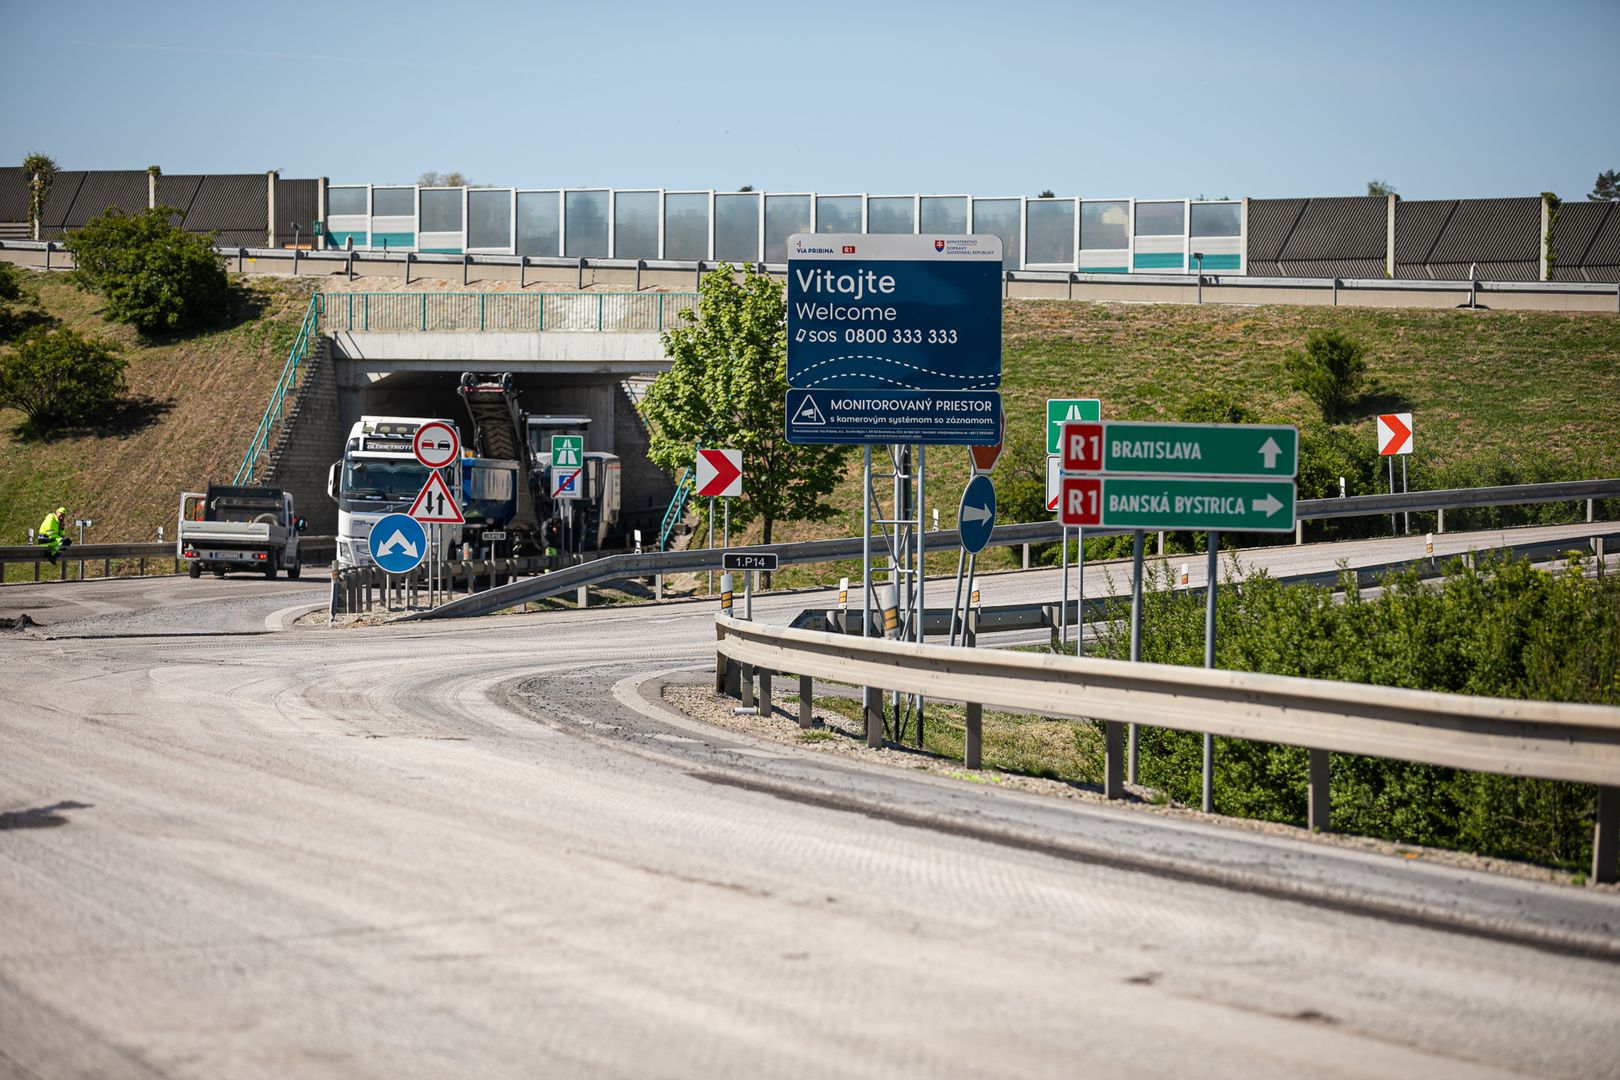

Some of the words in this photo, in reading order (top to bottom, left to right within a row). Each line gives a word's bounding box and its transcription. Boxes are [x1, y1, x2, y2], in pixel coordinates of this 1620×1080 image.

[796, 269, 896, 300] Vitajte
[796, 302, 897, 321] Welcome
[845, 328, 887, 343] 0800
[892, 330, 922, 344] 333
[928, 330, 958, 344] 333
[830, 398, 933, 411] MONITOROVANÝ
[936, 400, 992, 412] PRIESTOR
[836, 415, 887, 424] kamerovým
[888, 416, 932, 425] systémom
[946, 417, 995, 425] záznamom.
[1069, 434, 1099, 461] R1
[1111, 440, 1202, 460] BRATISLAVA
[1067, 488, 1098, 516] R1
[1109, 491, 1170, 513] BANSKÁ
[1174, 495, 1246, 515] BYSTRICA
[735, 557, 766, 567] 1.P14
